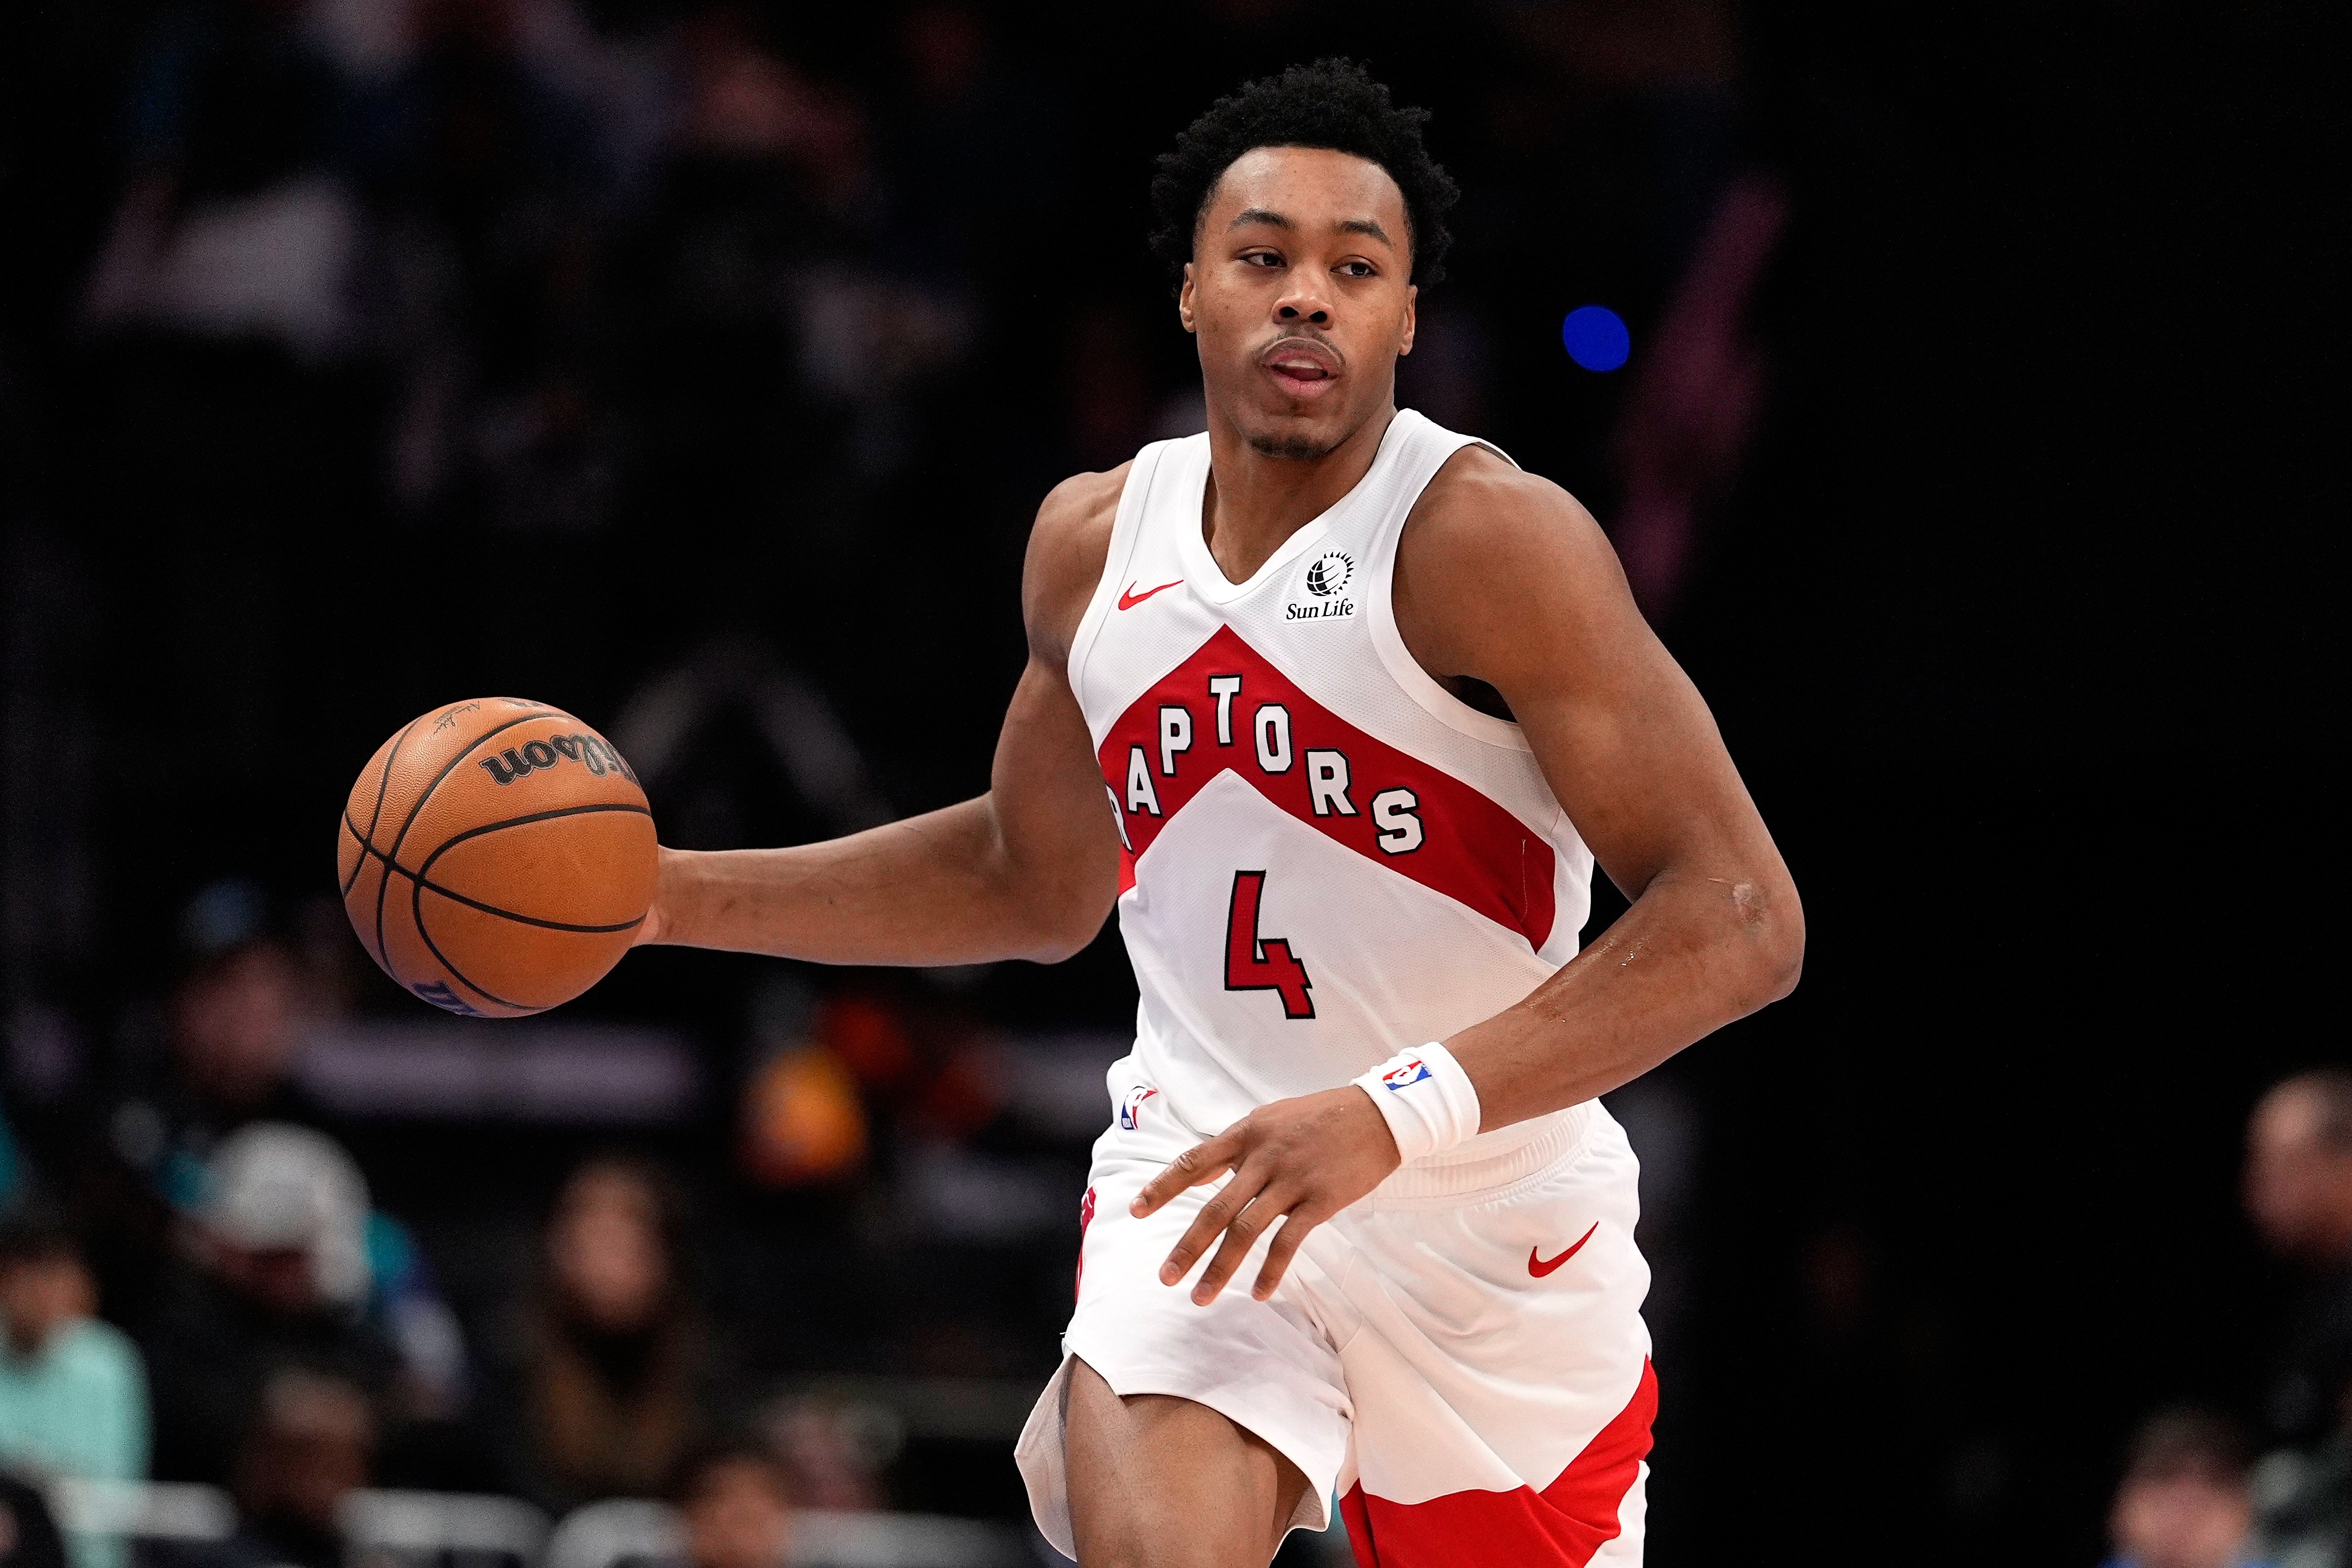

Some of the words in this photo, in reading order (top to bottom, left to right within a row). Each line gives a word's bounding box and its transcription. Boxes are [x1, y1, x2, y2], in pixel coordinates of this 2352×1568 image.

[1286, 603, 1319, 620] Sun
[1322, 598, 1353, 617] Life
[1224, 869, 1316, 1019] 4
